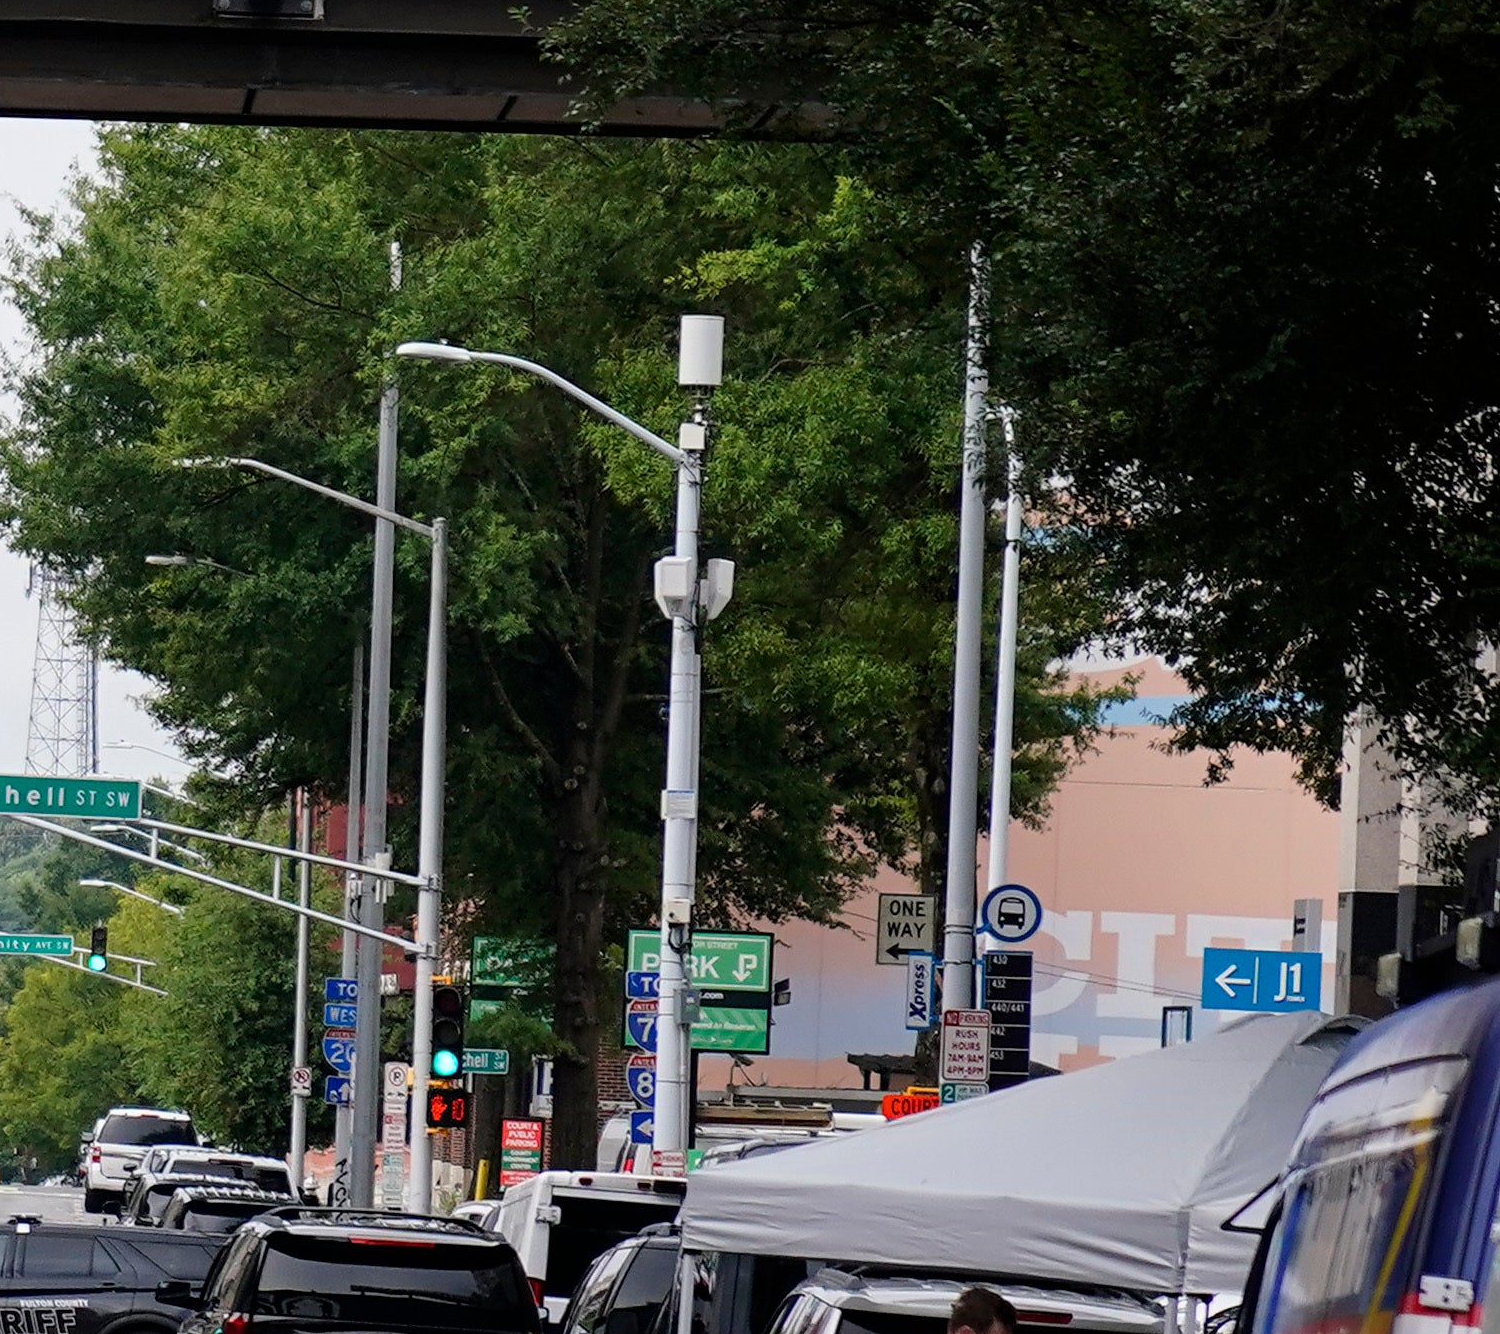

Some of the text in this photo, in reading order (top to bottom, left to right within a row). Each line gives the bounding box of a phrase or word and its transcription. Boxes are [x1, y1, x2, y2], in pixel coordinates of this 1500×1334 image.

[76, 790, 97, 806] ST
[105, 791, 131, 808] SW
[889, 900, 926, 917] ONE
[887, 922, 927, 939] WAY
[35, 941, 53, 950] AVE
[641, 953, 721, 979] PRK
[337, 982, 358, 997] TO
[1273, 961, 1303, 1003] J1
[330, 1006, 357, 1023] WES
[636, 1018, 655, 1043] 7
[955, 1030, 979, 1039] RUSH
[951, 1042, 981, 1051] HOURS
[636, 1071, 654, 1098] 8
[19, 1298, 89, 1308] FULTON COUNTY
